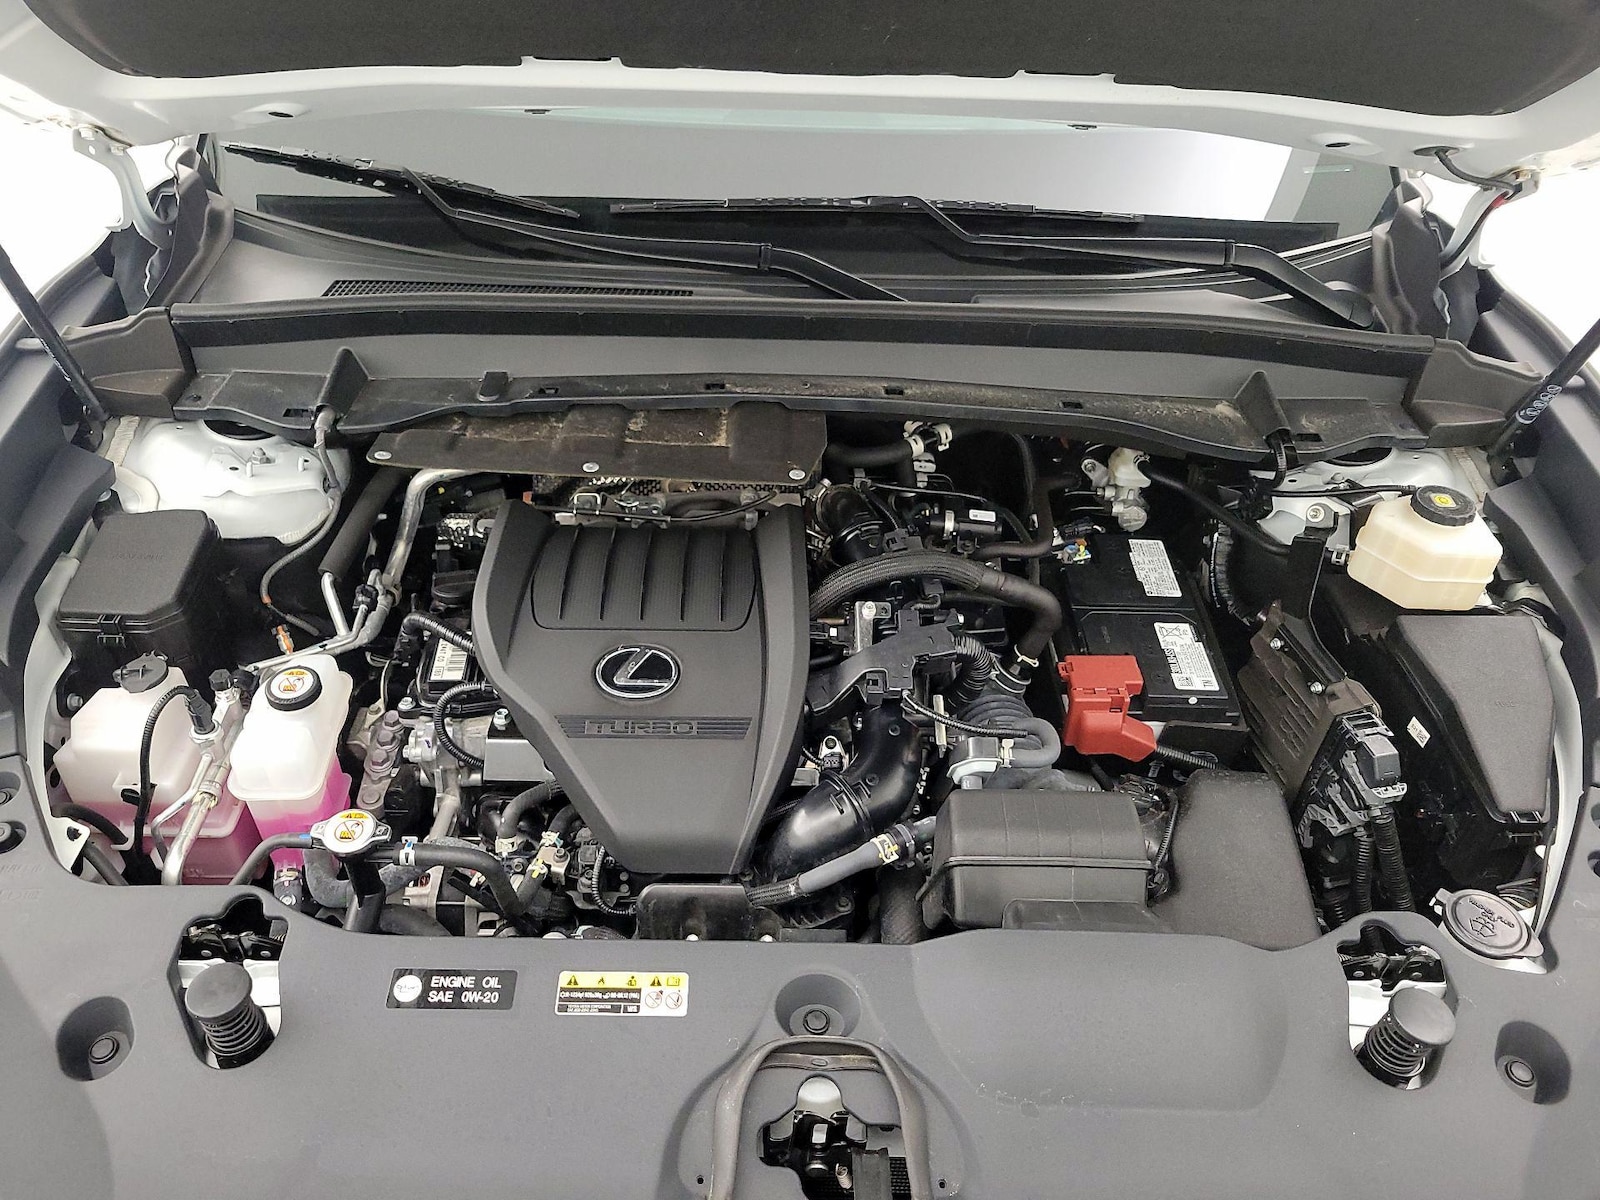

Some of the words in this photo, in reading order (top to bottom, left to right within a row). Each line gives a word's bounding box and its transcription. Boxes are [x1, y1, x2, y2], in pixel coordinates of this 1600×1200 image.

[588, 720, 694, 735] TURBO
[430, 976, 475, 988] ENGINE
[482, 977, 501, 989] OIL
[427, 991, 454, 1003] SAE
[461, 991, 499, 1003] 0W-20
